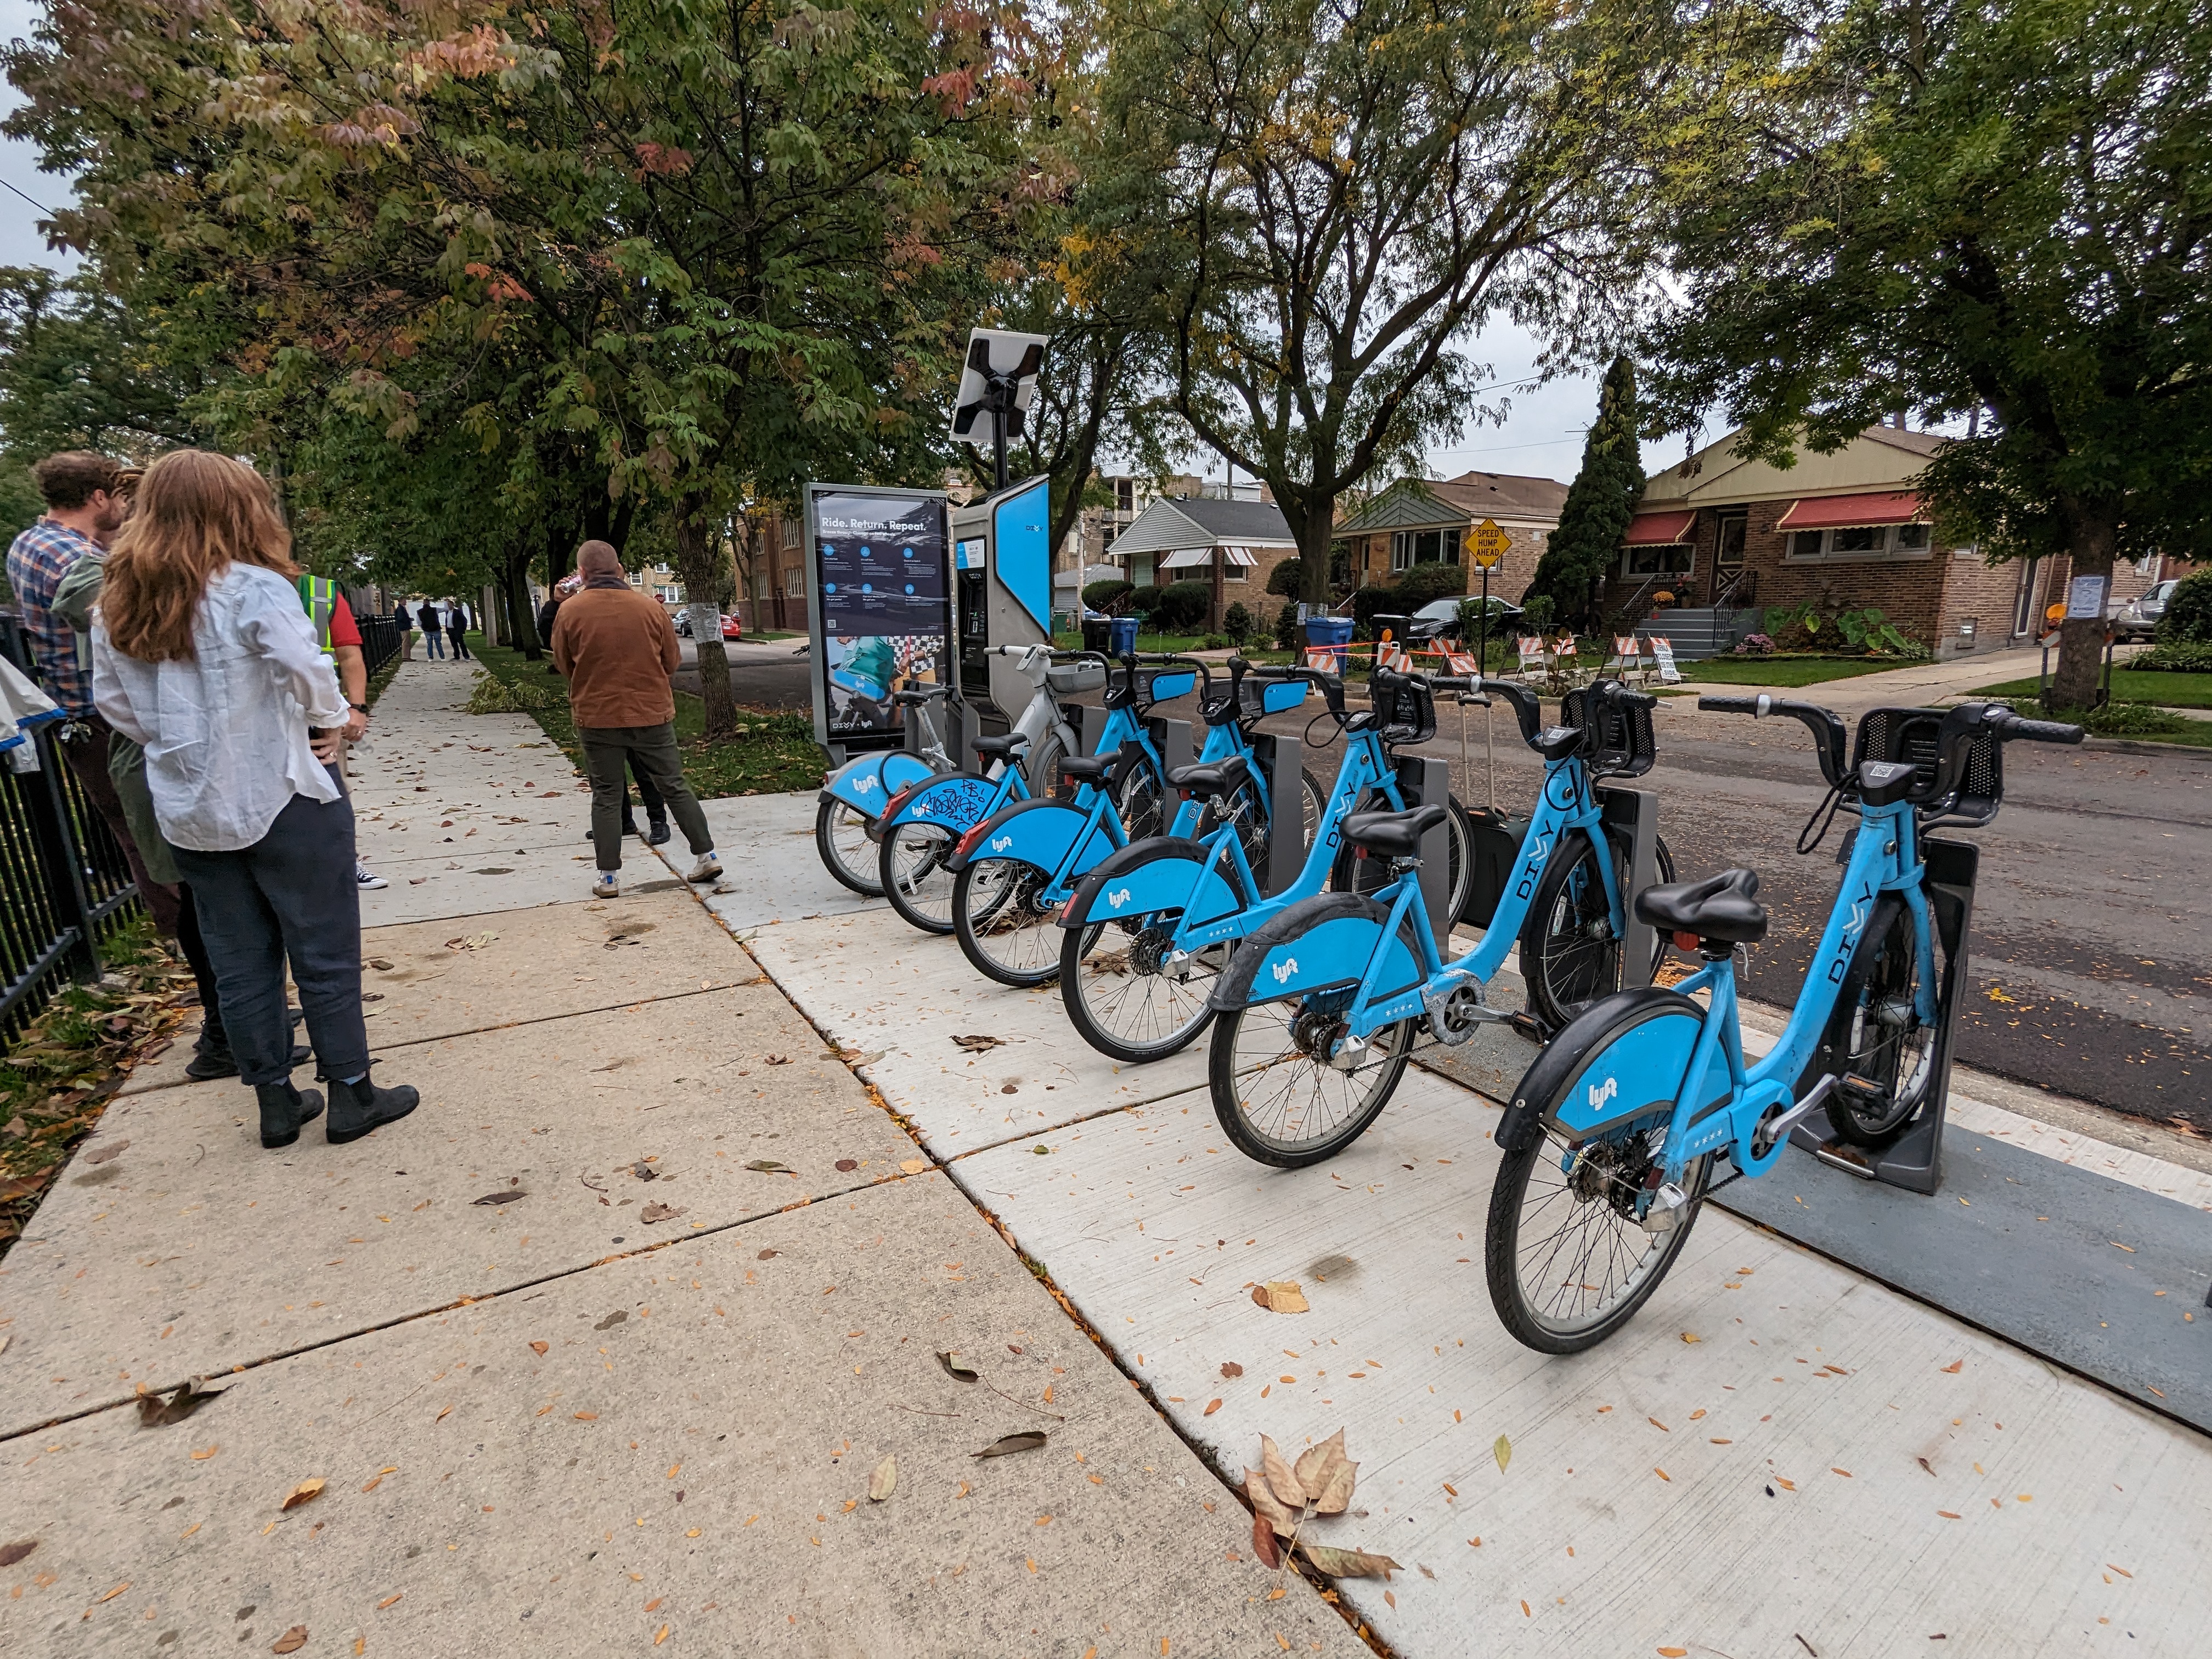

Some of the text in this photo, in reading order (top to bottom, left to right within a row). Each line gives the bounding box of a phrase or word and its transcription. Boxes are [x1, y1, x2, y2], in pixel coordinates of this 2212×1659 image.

[822, 517, 927, 532] Ride. Return. Repeat.
[1477, 529, 1499, 538] SPEED
[1479, 539, 1498, 547] HUMP
[861, 720, 873, 728] lyft
[853, 775, 879, 794] lyft
[992, 836, 1012, 853] lyft
[1516, 819, 1554, 901] DIVVY
[1109, 888, 1131, 909] lyft
[1828, 881, 1873, 985] DIVVY
[1273, 958, 1299, 984] lyft
[1589, 1077, 1617, 1111] lyft
